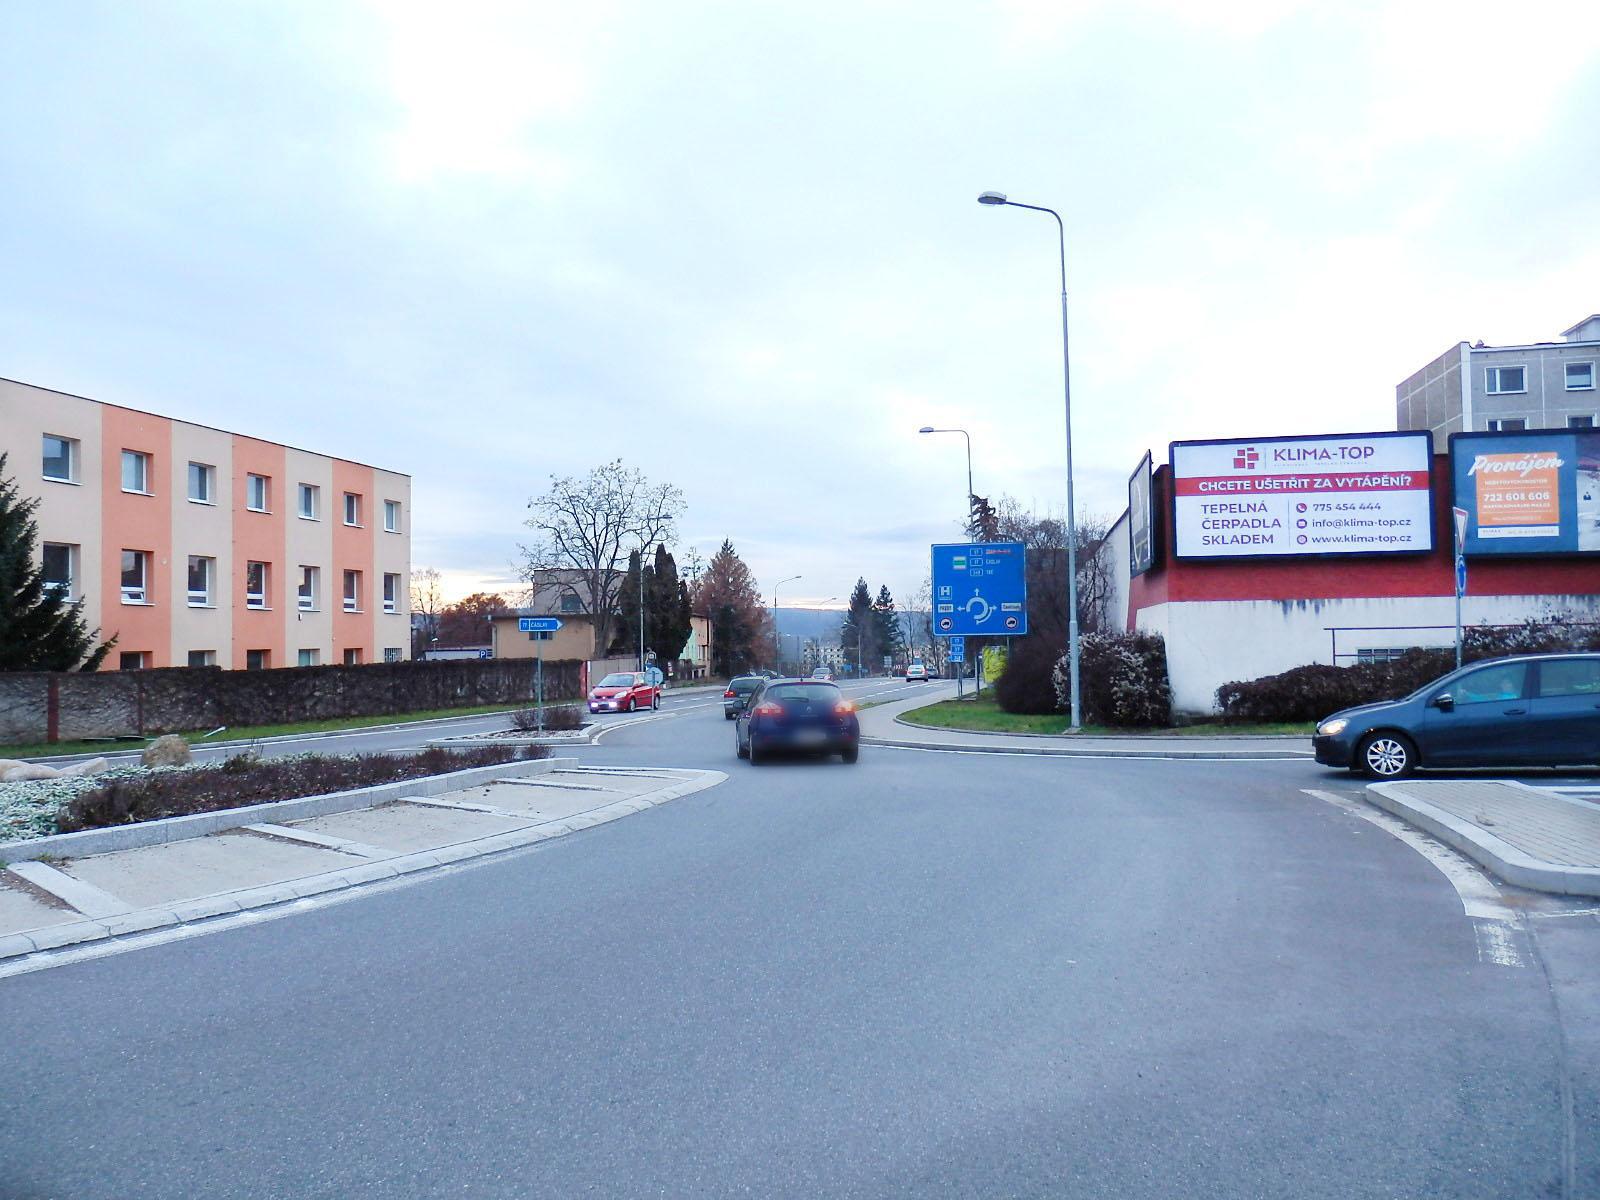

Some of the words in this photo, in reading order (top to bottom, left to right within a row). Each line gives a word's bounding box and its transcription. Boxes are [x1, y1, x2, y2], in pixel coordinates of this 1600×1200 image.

[1273, 446, 1375, 462] KLIMA-TOP
[1467, 455, 1565, 477] Pronájem
[1199, 481, 1251, 492] CHCETE
[1255, 478, 1310, 490] UŠETŘIT
[1313, 478, 1332, 489] ZA
[1335, 474, 1412, 488] VYTÁPĚNÍ?
[1483, 493, 1503, 502] 722
[1201, 500, 1268, 514] TEPELNÁ
[1313, 503, 1332, 512] 775
[1335, 503, 1356, 512] 454
[1358, 502, 1382, 511] 444
[1201, 517, 1281, 530] ČERPADLA
[1312, 518, 1412, 529] info@klima-top.cz
[1202, 534, 1274, 545] SKLADEM
[1312, 534, 1412, 545] www.klima-top.cz
